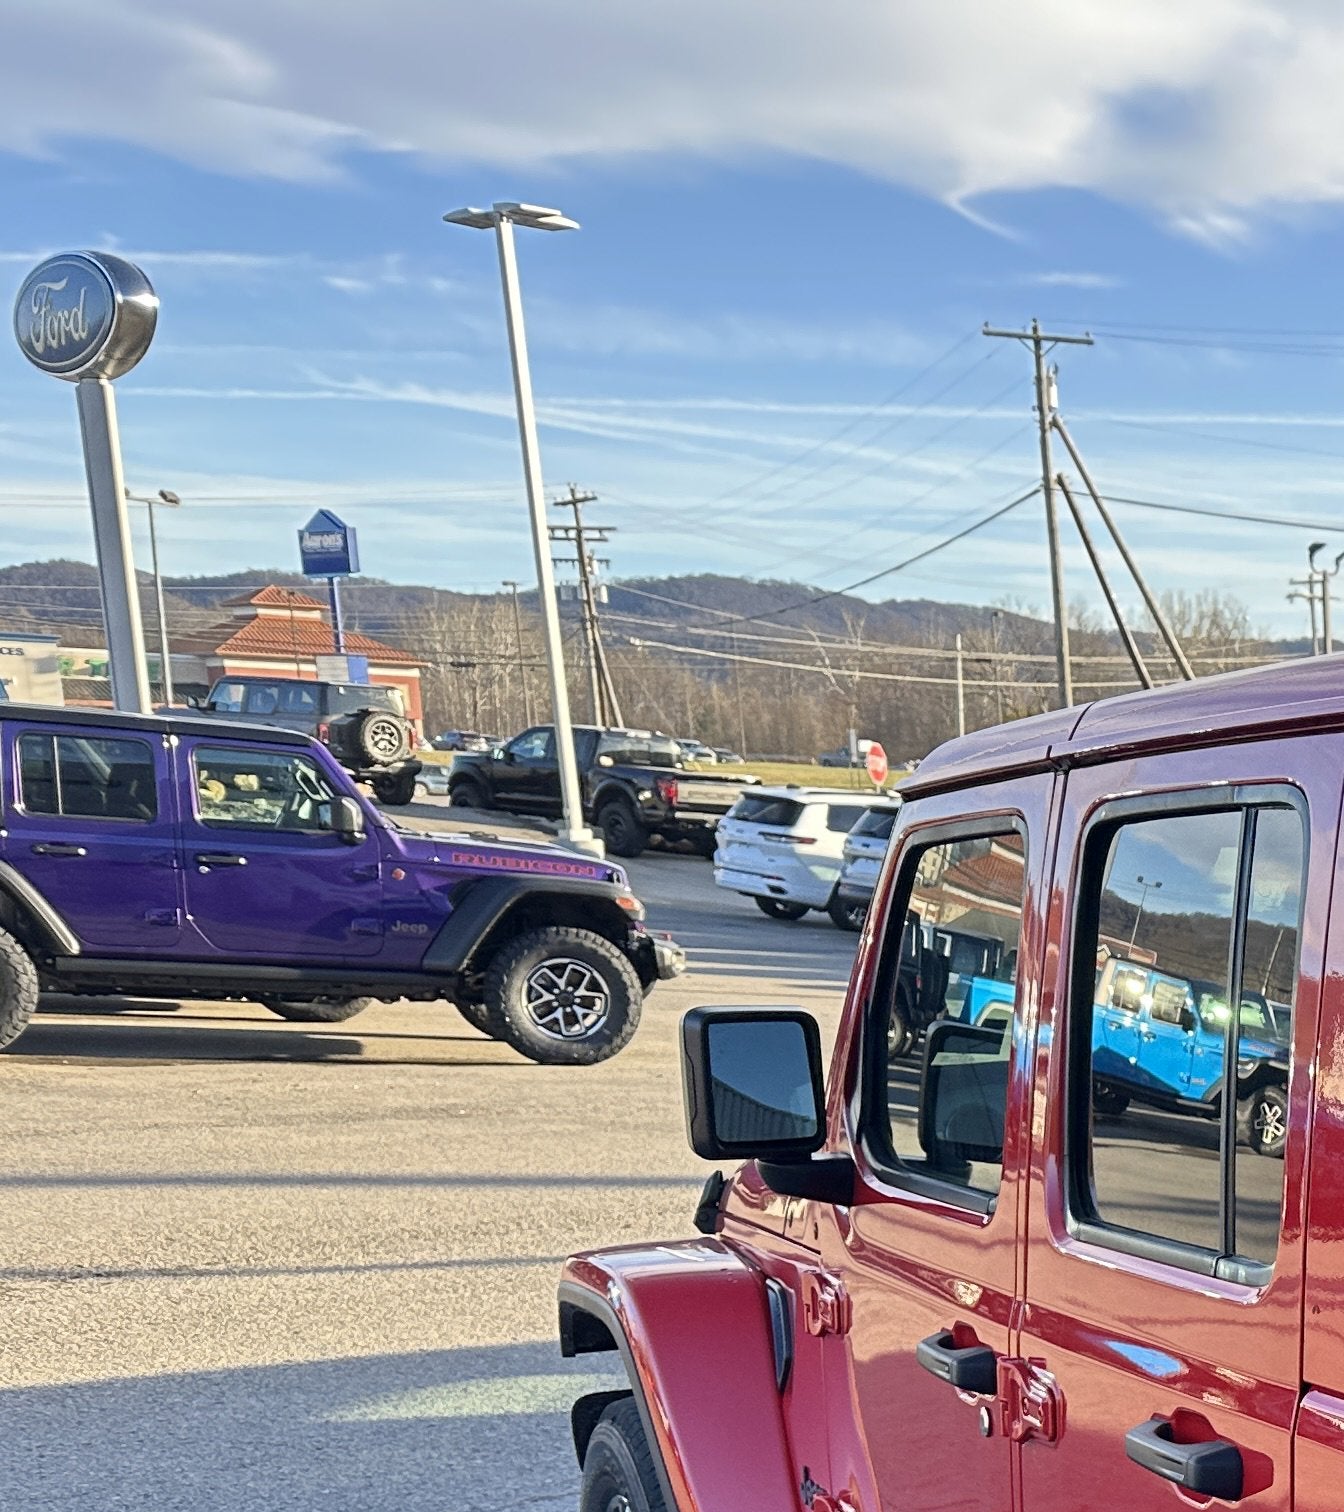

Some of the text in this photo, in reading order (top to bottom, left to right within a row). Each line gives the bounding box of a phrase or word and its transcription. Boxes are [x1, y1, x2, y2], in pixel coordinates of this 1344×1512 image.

[31, 276, 88, 353] Ford
[452, 852, 596, 877] RUBICON
[391, 919, 428, 935] Jeep
